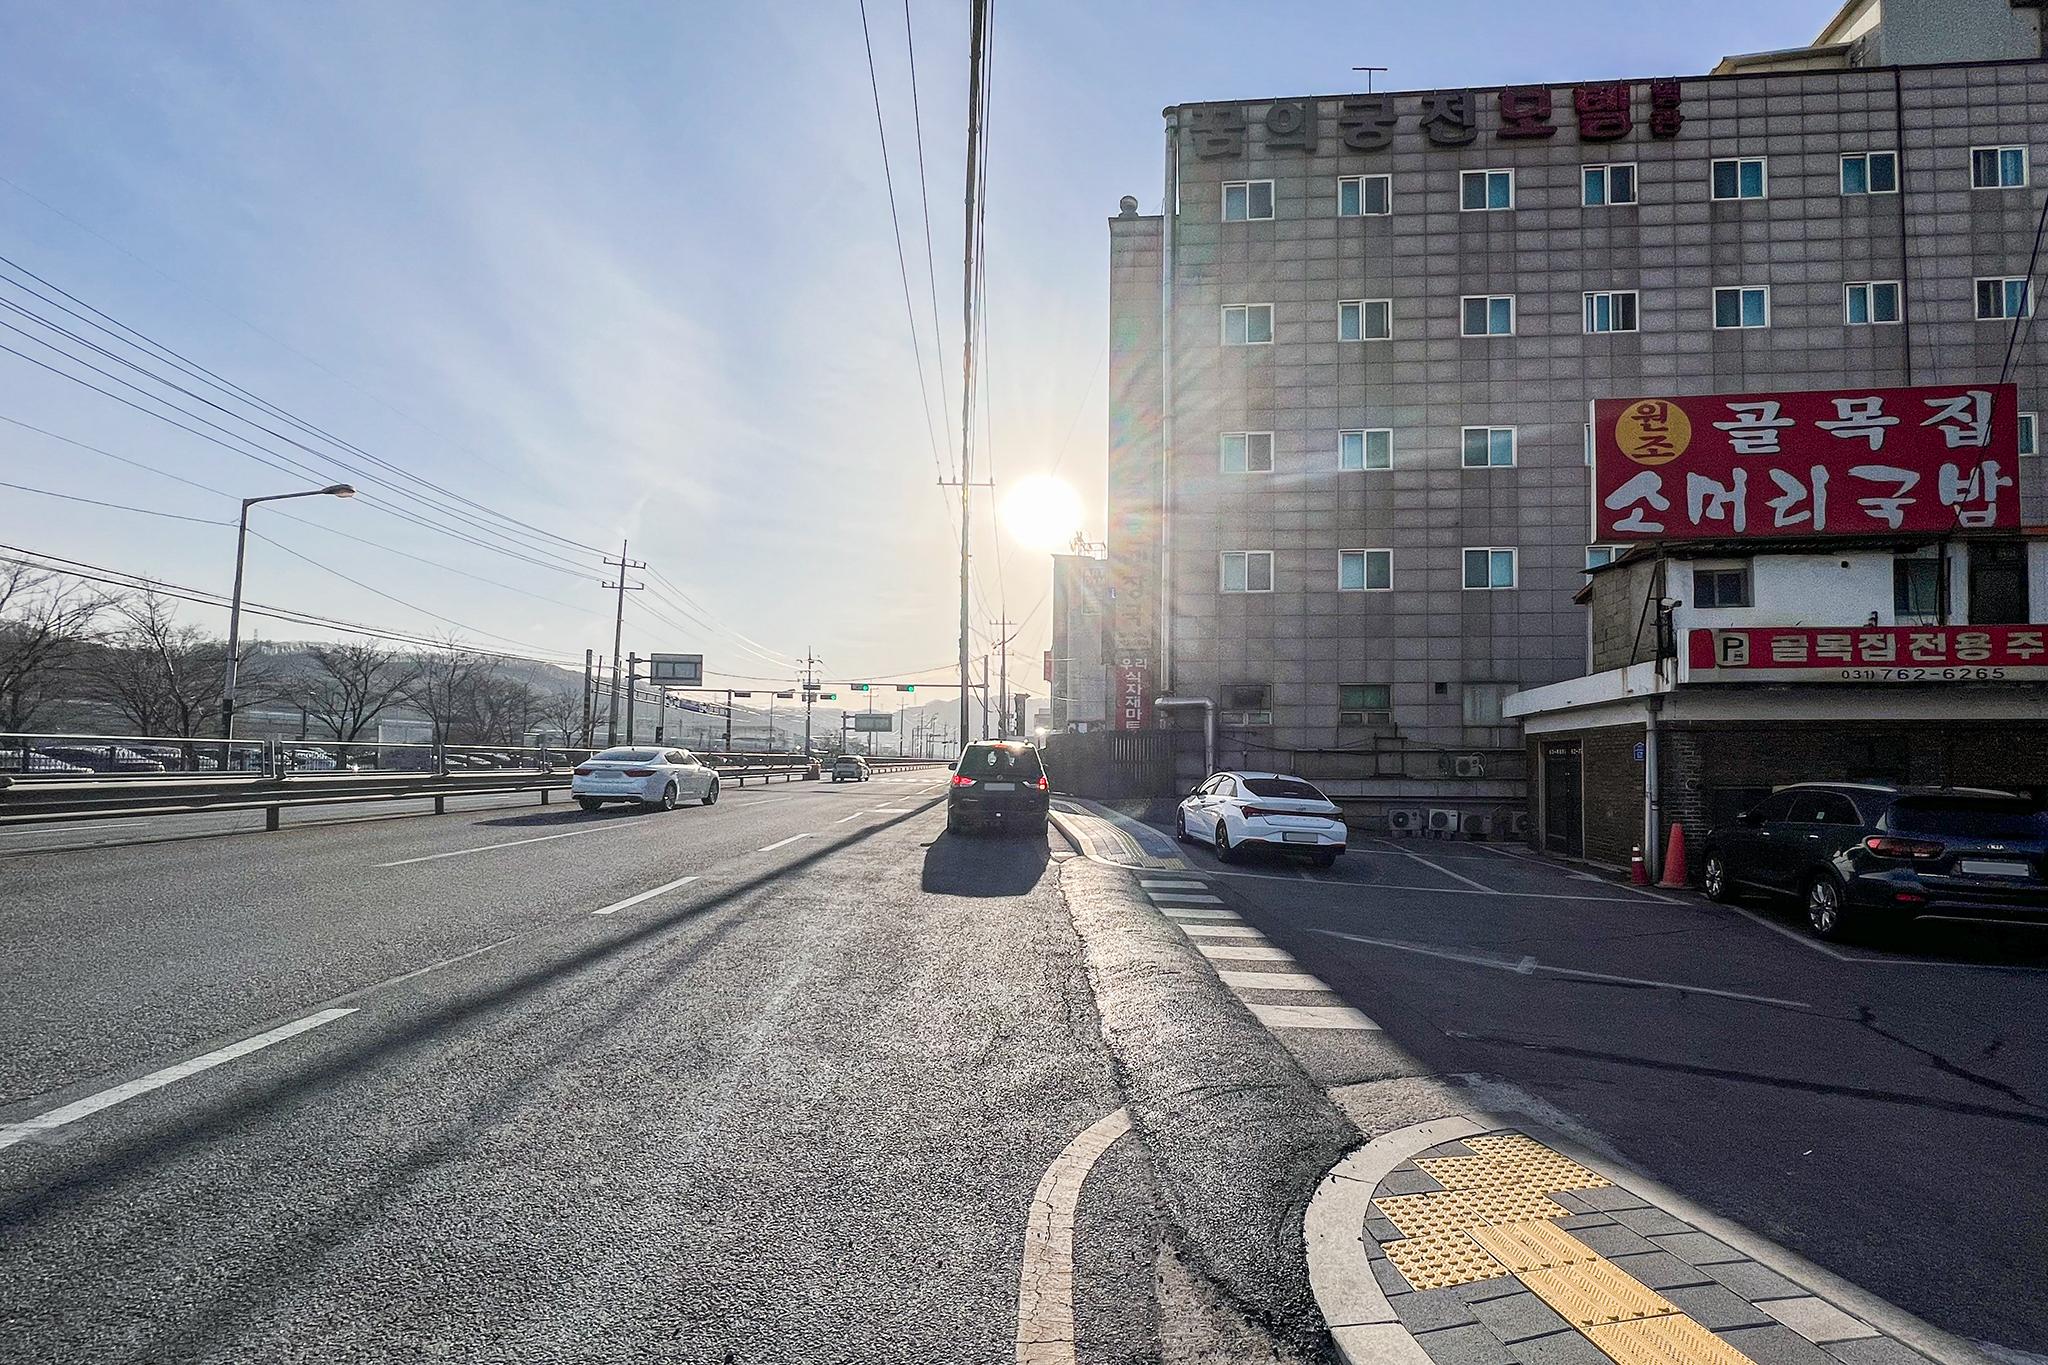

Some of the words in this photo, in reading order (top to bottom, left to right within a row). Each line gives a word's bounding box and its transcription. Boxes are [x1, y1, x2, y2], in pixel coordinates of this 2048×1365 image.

[1713, 391, 1994, 454] 골목집
[1771, 633, 1896, 662] 골목집
[1909, 632, 1993, 662] 전용
[1120, 658, 1148, 670] 우리
